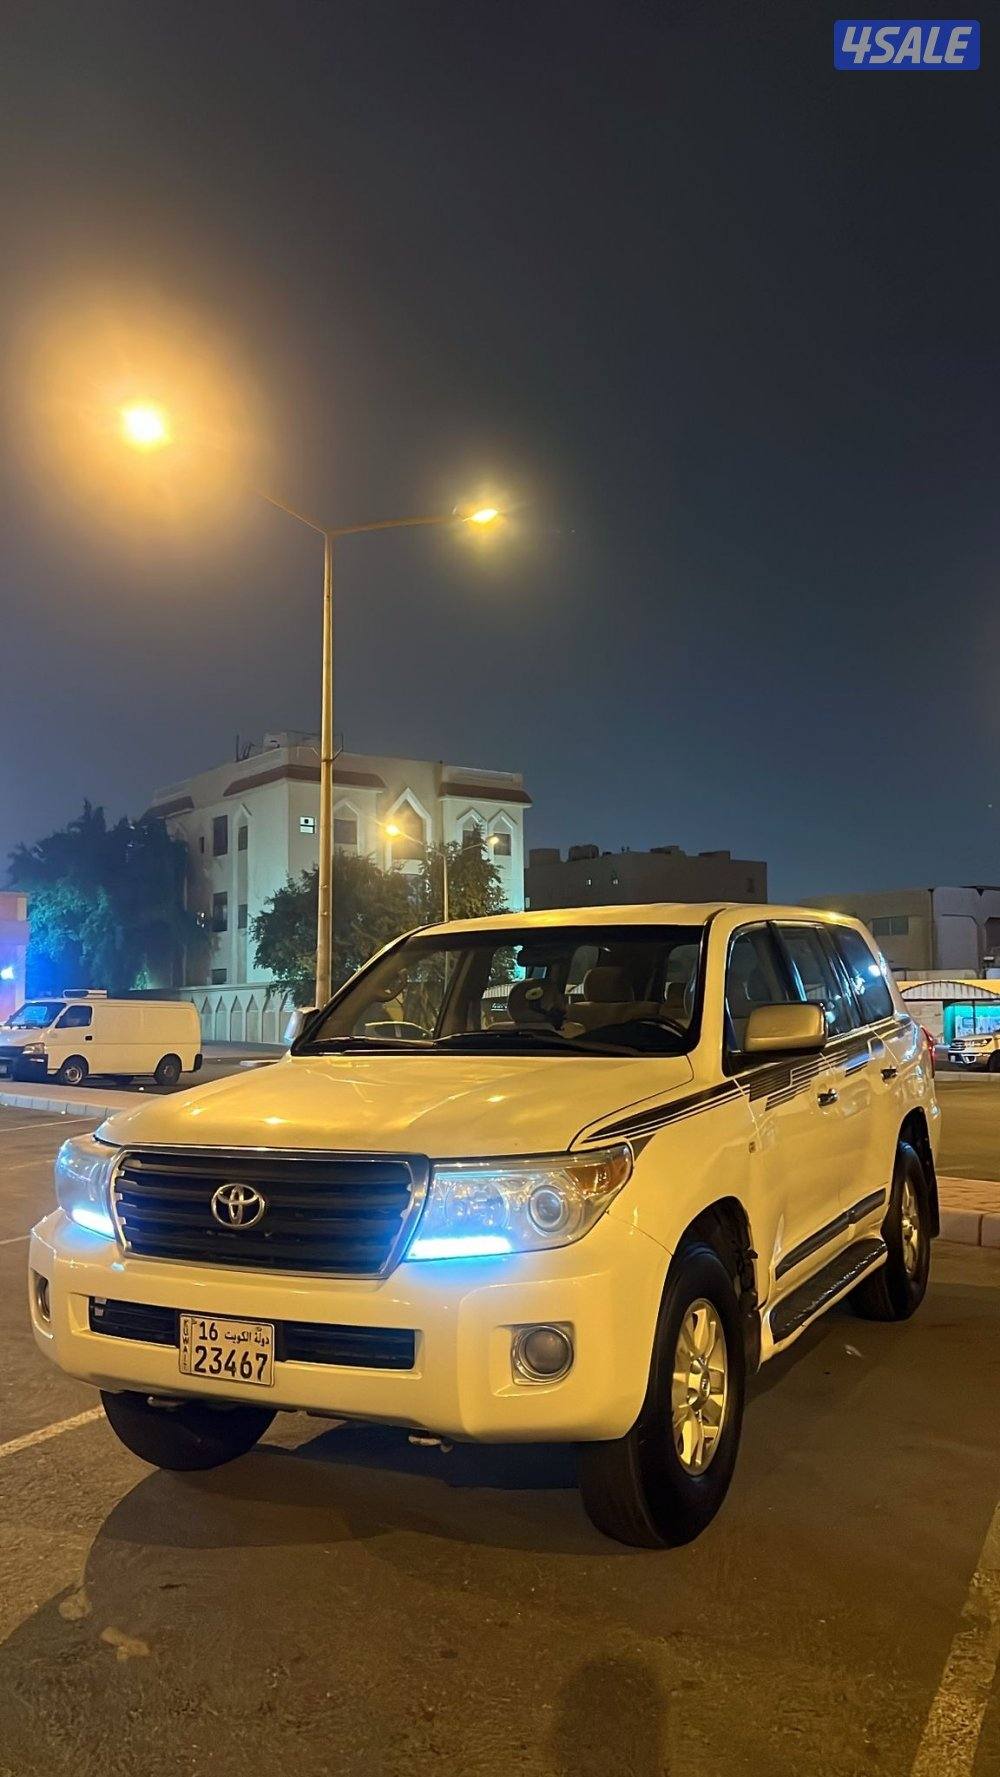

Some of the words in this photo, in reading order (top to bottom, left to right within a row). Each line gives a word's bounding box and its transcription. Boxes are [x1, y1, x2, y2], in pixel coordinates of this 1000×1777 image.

[199, 1321, 218, 1341] 16
[224, 1330, 252, 1344] الكويت
[254, 1331, 269, 1347] دولة
[194, 1345, 268, 1381] 23467
